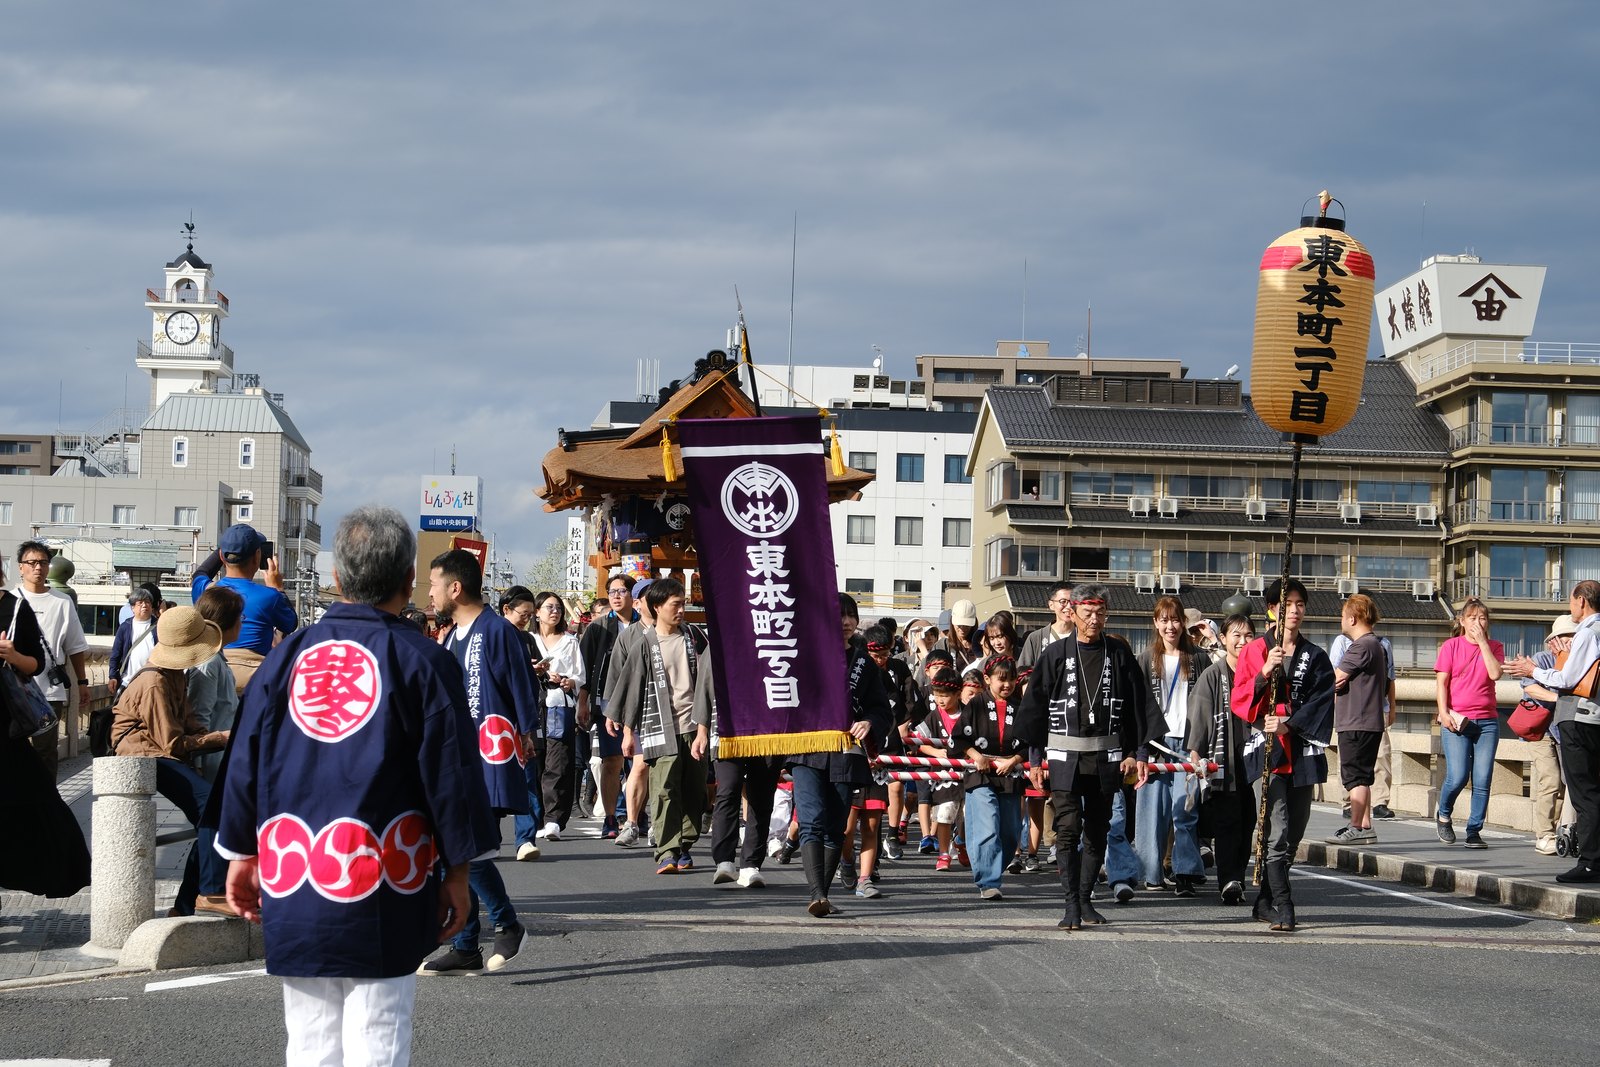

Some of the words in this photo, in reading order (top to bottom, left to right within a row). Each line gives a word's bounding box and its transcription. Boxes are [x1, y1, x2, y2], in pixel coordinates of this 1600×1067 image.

[1289, 234, 1349, 424] 東本町一丁目
[424, 490, 474, 509] しんぶん社
[746, 540, 801, 710] 東本町一丁目
